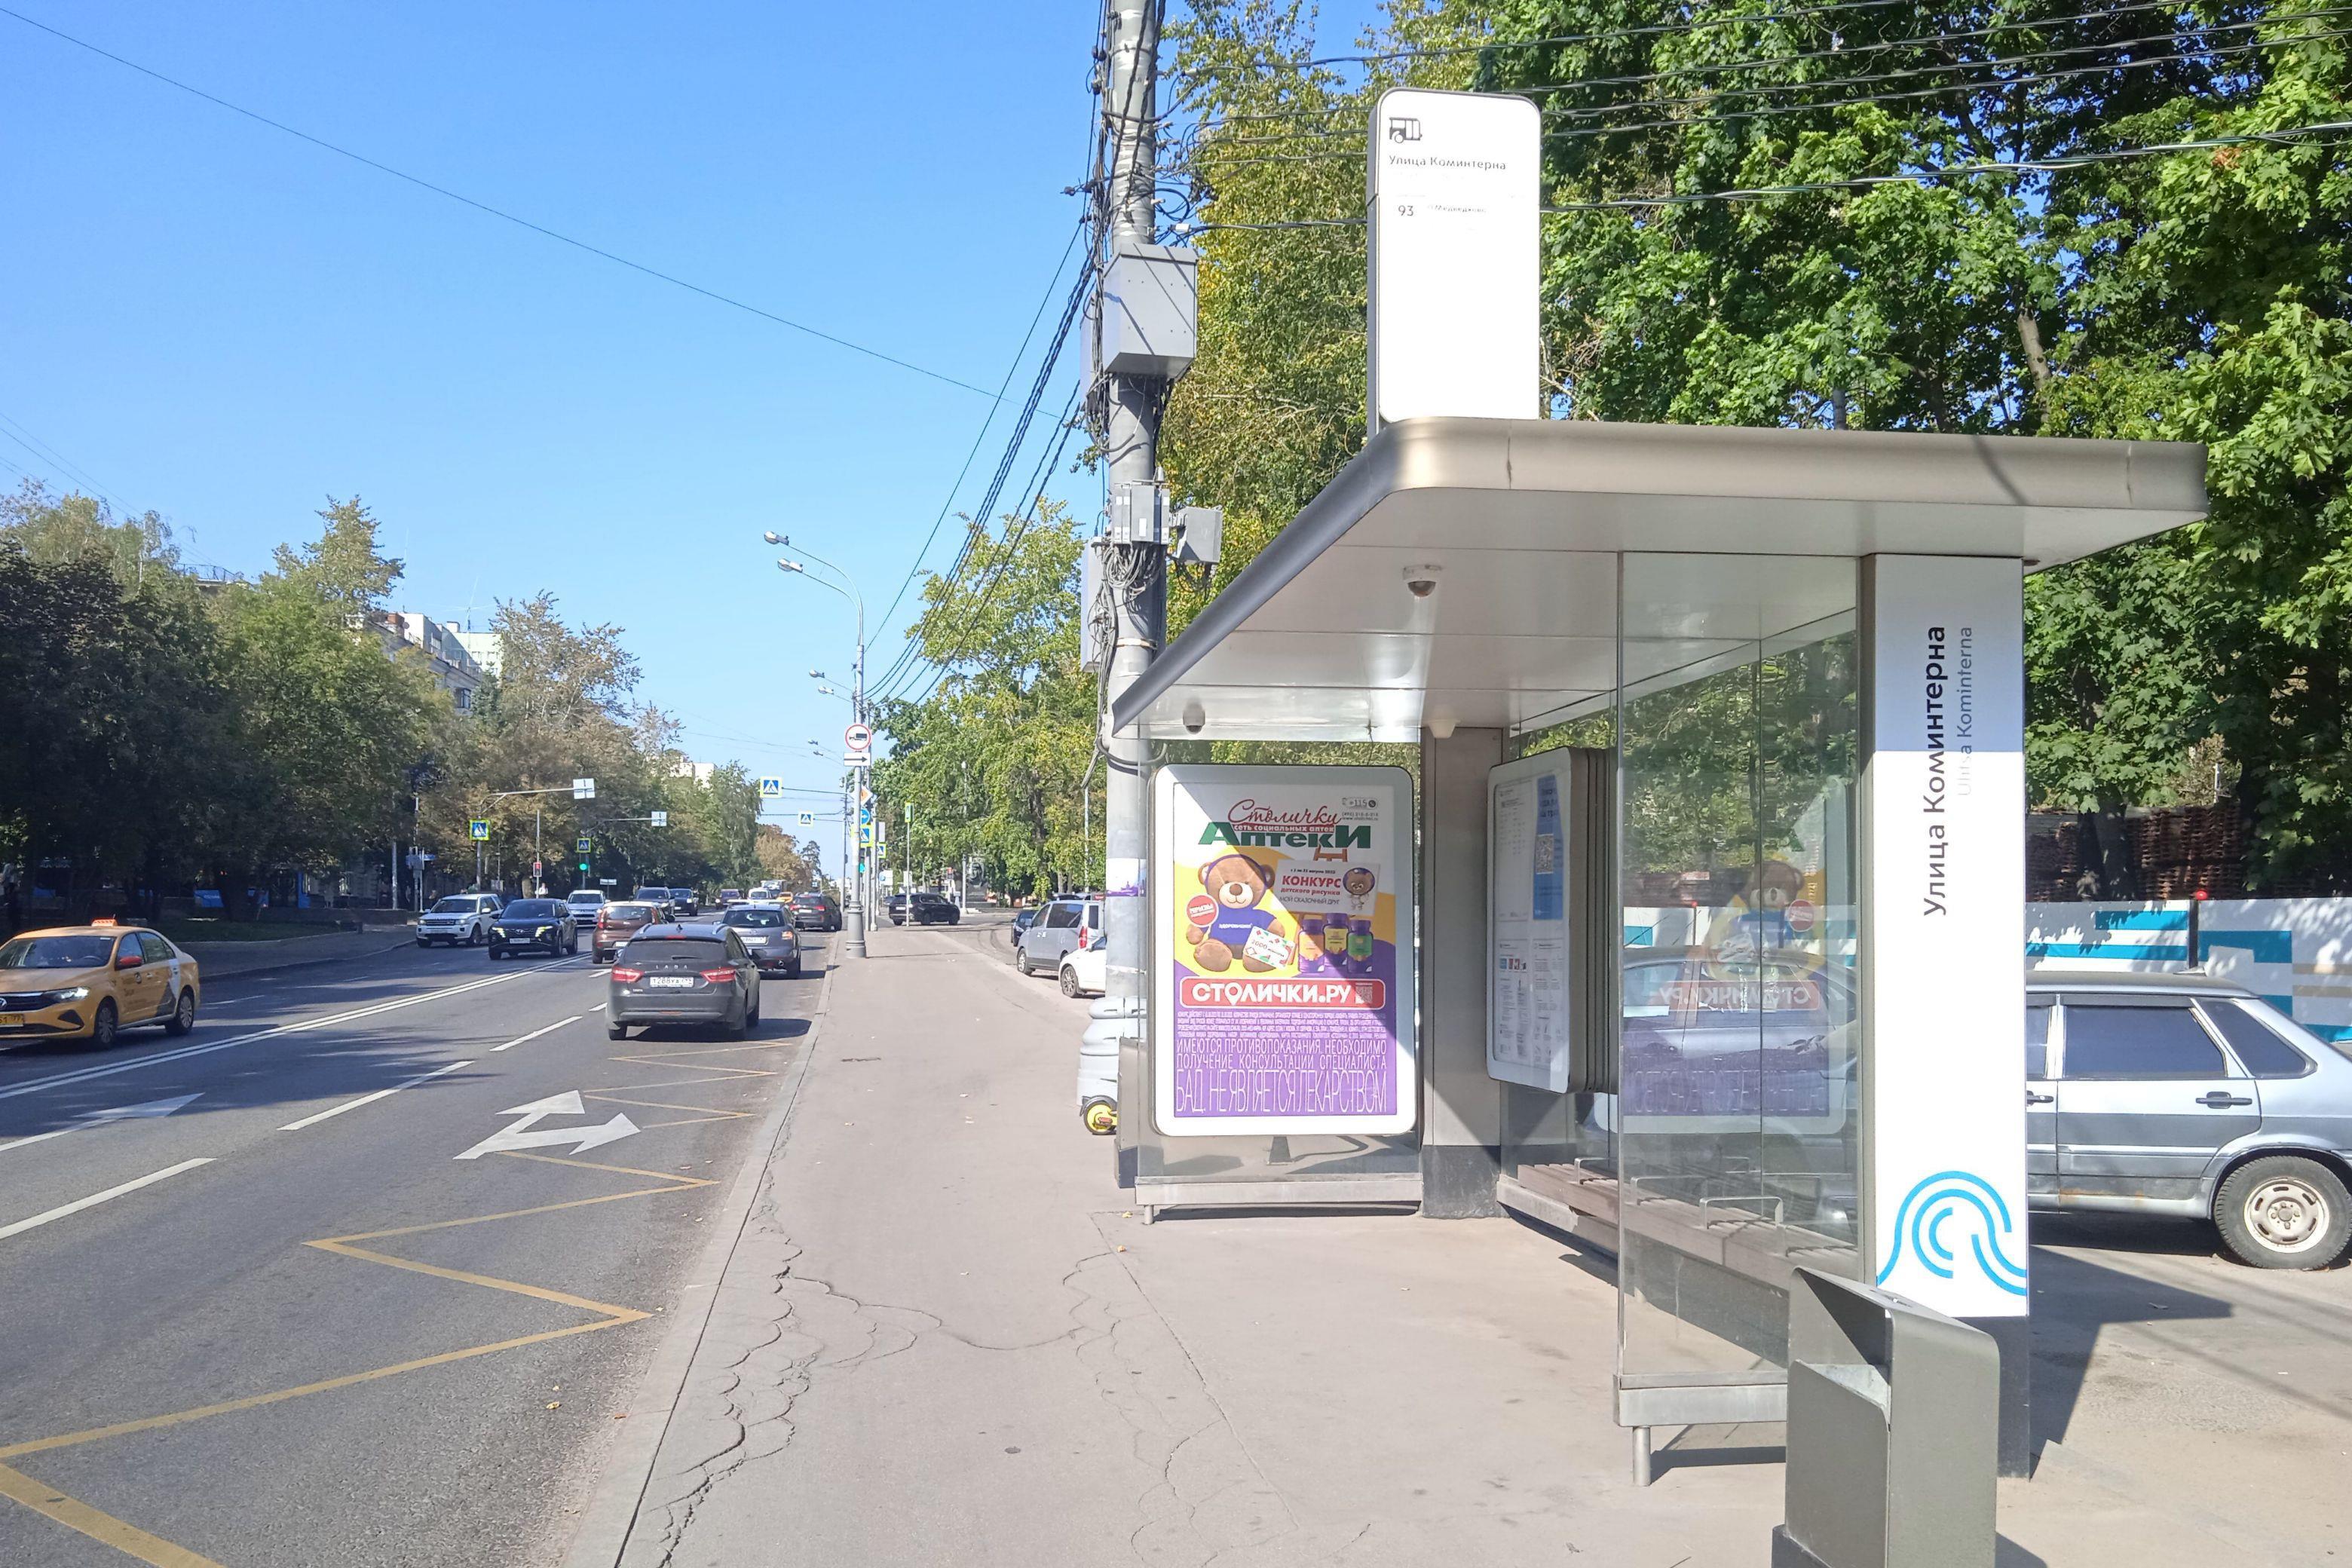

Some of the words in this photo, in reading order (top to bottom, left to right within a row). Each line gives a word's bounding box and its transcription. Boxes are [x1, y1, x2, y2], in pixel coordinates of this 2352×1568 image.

[1389, 155, 1426, 167] Улица
[1430, 156, 1506, 170] Коминтерна
[1398, 205, 1414, 216] 93
[1956, 626, 1972, 738] Kominterna
[1923, 626, 1948, 813] Коминтерна
[1228, 799, 1343, 824] Столички
[1923, 825, 1948, 916] Улица
[1282, 875, 1342, 888] КОНКУРС
[1294, 896, 1327, 905] СКАЗОЧНЫЙ
[1192, 982, 1352, 1006] СТОЛИЧКИ.РУ
[1177, 1038, 1221, 1055] ИМЕЮТСЯ
[1325, 1038, 1386, 1055] НЕОБХОДИМО
[1177, 1055, 1233, 1069] ПОЛУЧЕНИЕ
[1239, 1054, 1314, 1070] КОНСУЛЬТАЦИИ
[1319, 1054, 1386, 1070] СПЕЦИАЛИСТА
[1209, 1069, 1228, 1112] НЕ
[1229, 1069, 1296, 1112] ЯВЛЯЕТСЯ
[1297, 1069, 1387, 1112] ЛЕКАРСТВОМ
